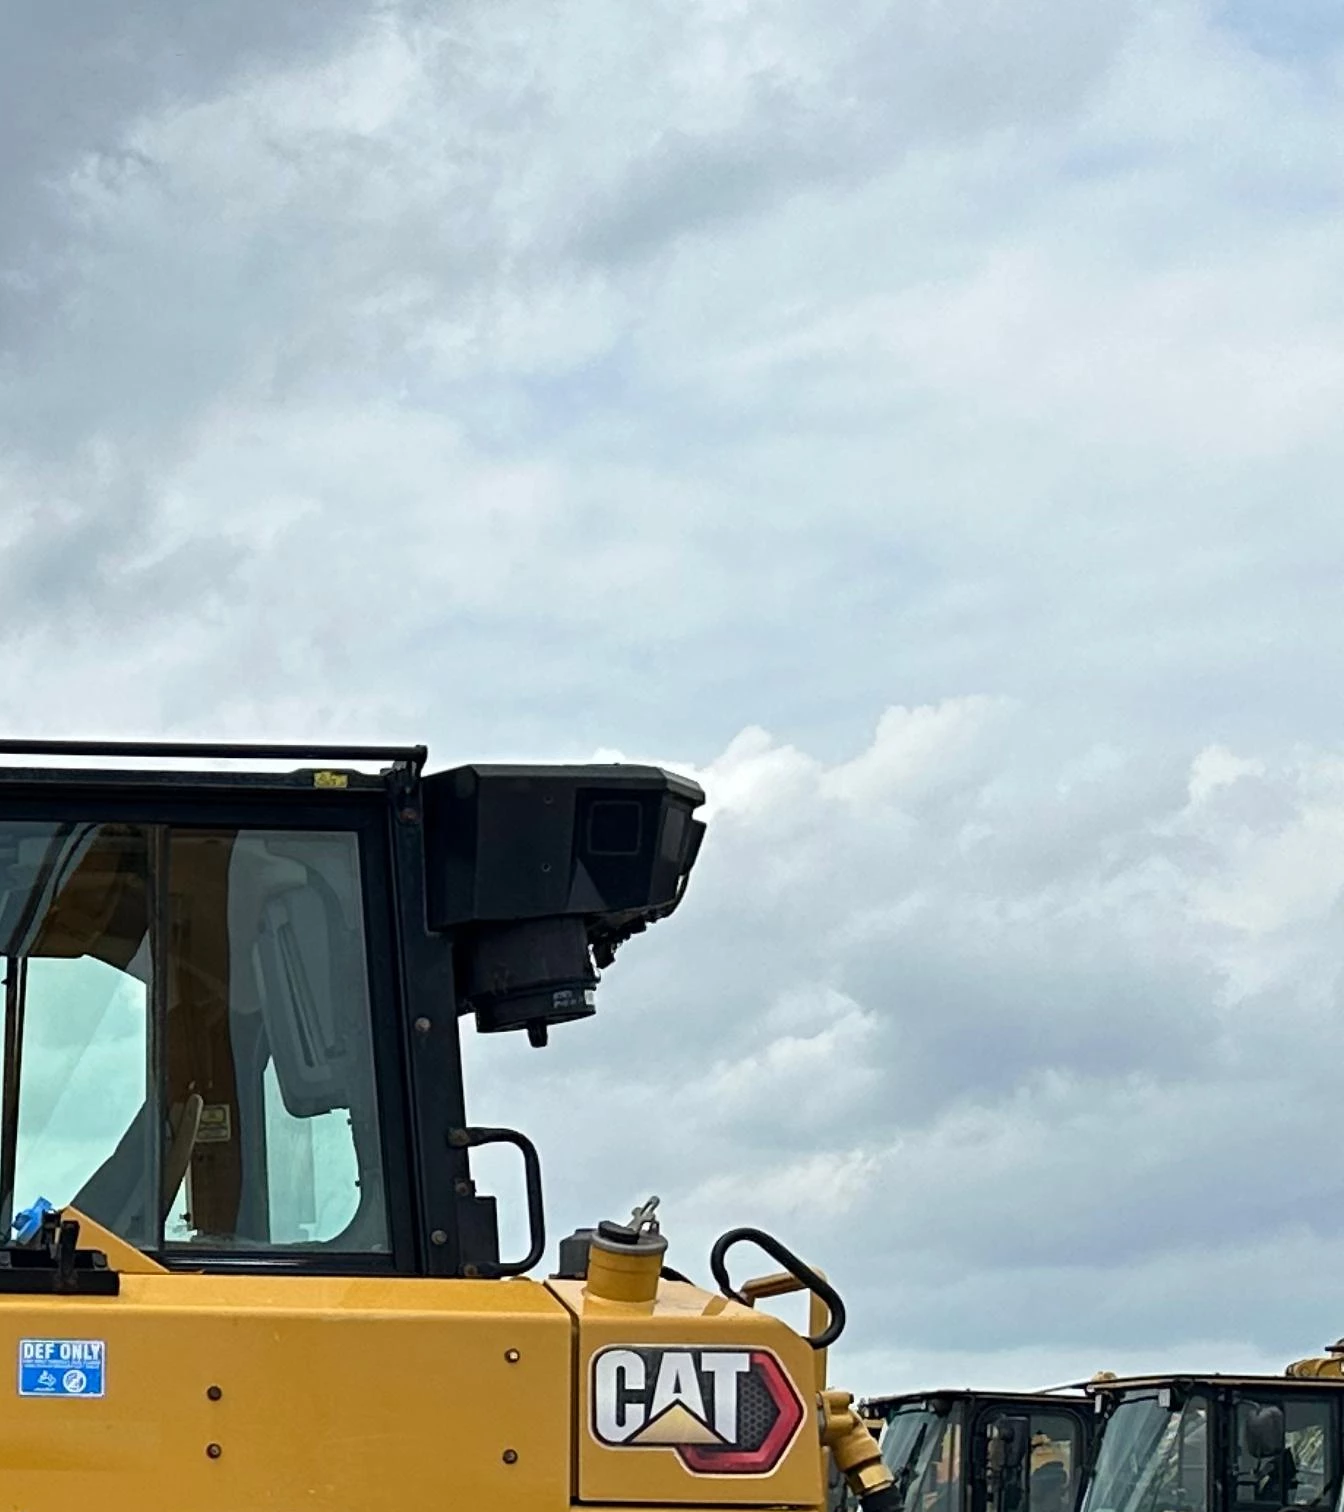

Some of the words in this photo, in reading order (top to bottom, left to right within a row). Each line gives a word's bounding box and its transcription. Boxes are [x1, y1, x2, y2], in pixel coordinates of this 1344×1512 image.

[23, 1343, 55, 1359] DEF
[59, 1343, 100, 1361] ONLY
[596, 1350, 750, 1444] CAT
